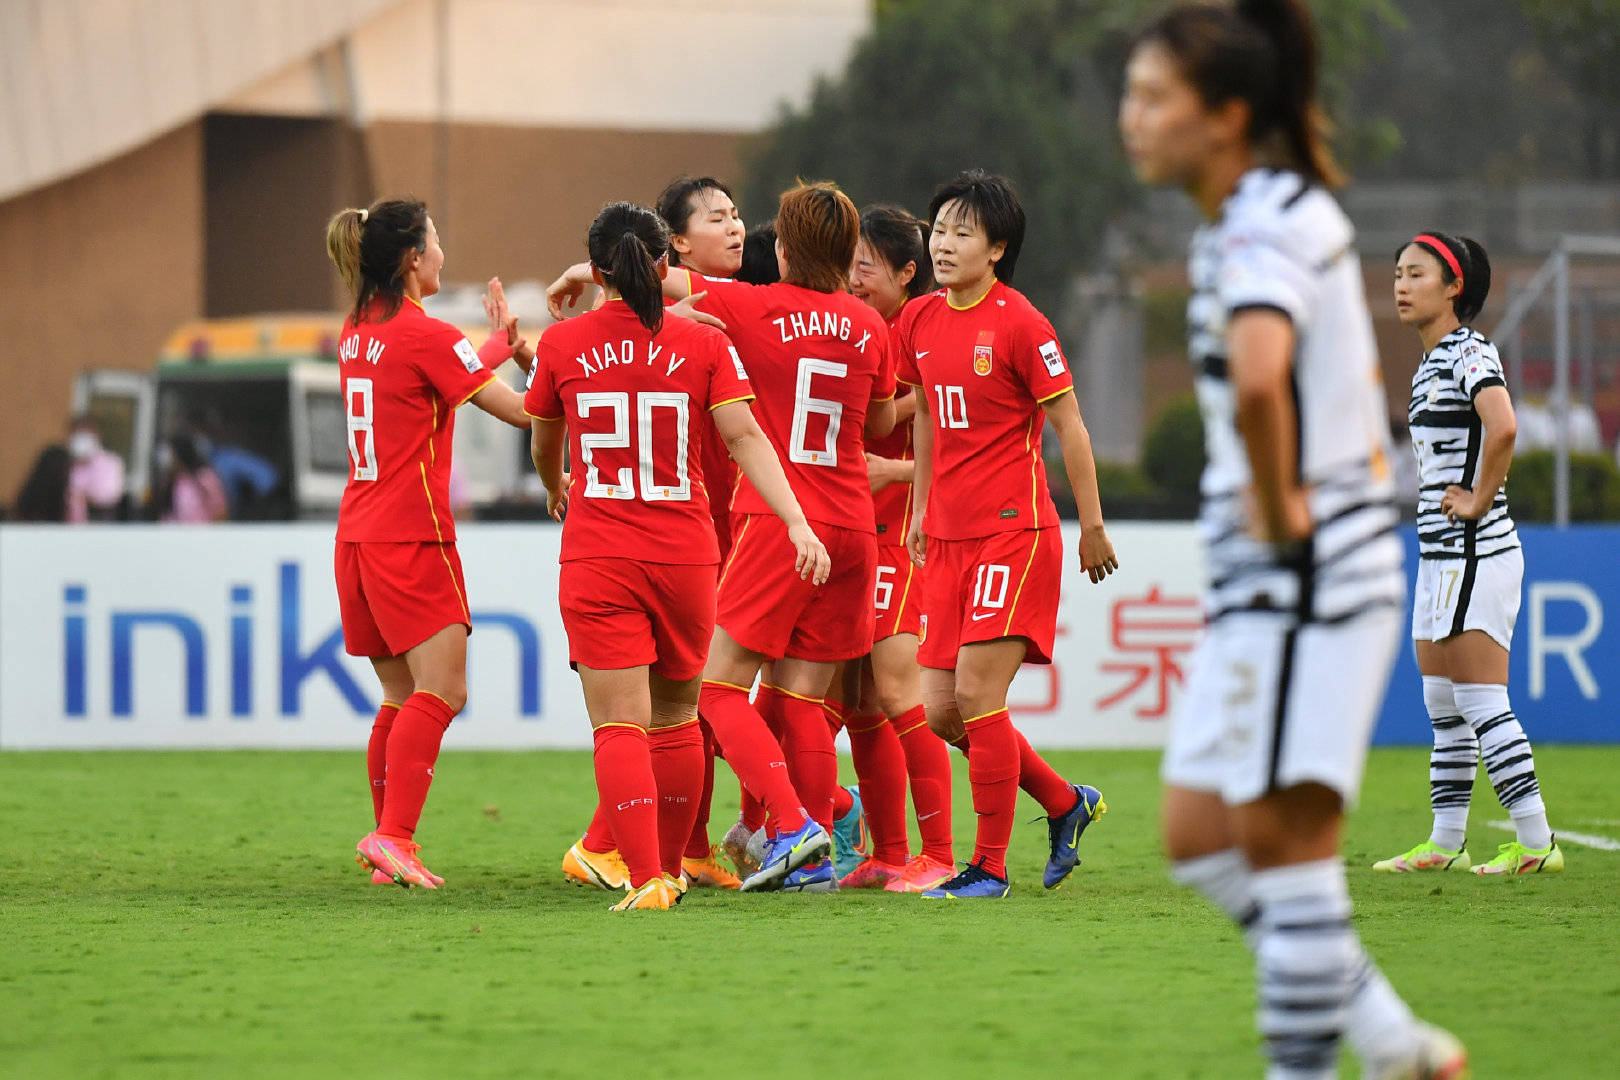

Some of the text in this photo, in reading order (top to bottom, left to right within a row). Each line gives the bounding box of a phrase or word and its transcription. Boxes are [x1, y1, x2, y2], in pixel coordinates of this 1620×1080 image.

[366, 336, 386, 365] W
[772, 311, 871, 353] ZHANG X
[576, 340, 686, 378] XIAO Y Y
[790, 357, 848, 467] 6
[934, 384, 969, 429] 10
[347, 378, 378, 481] 8
[576, 392, 691, 502] 20
[973, 564, 1010, 608] 10
[1436, 570, 1459, 611] 17
[62, 562, 542, 717] inikn
